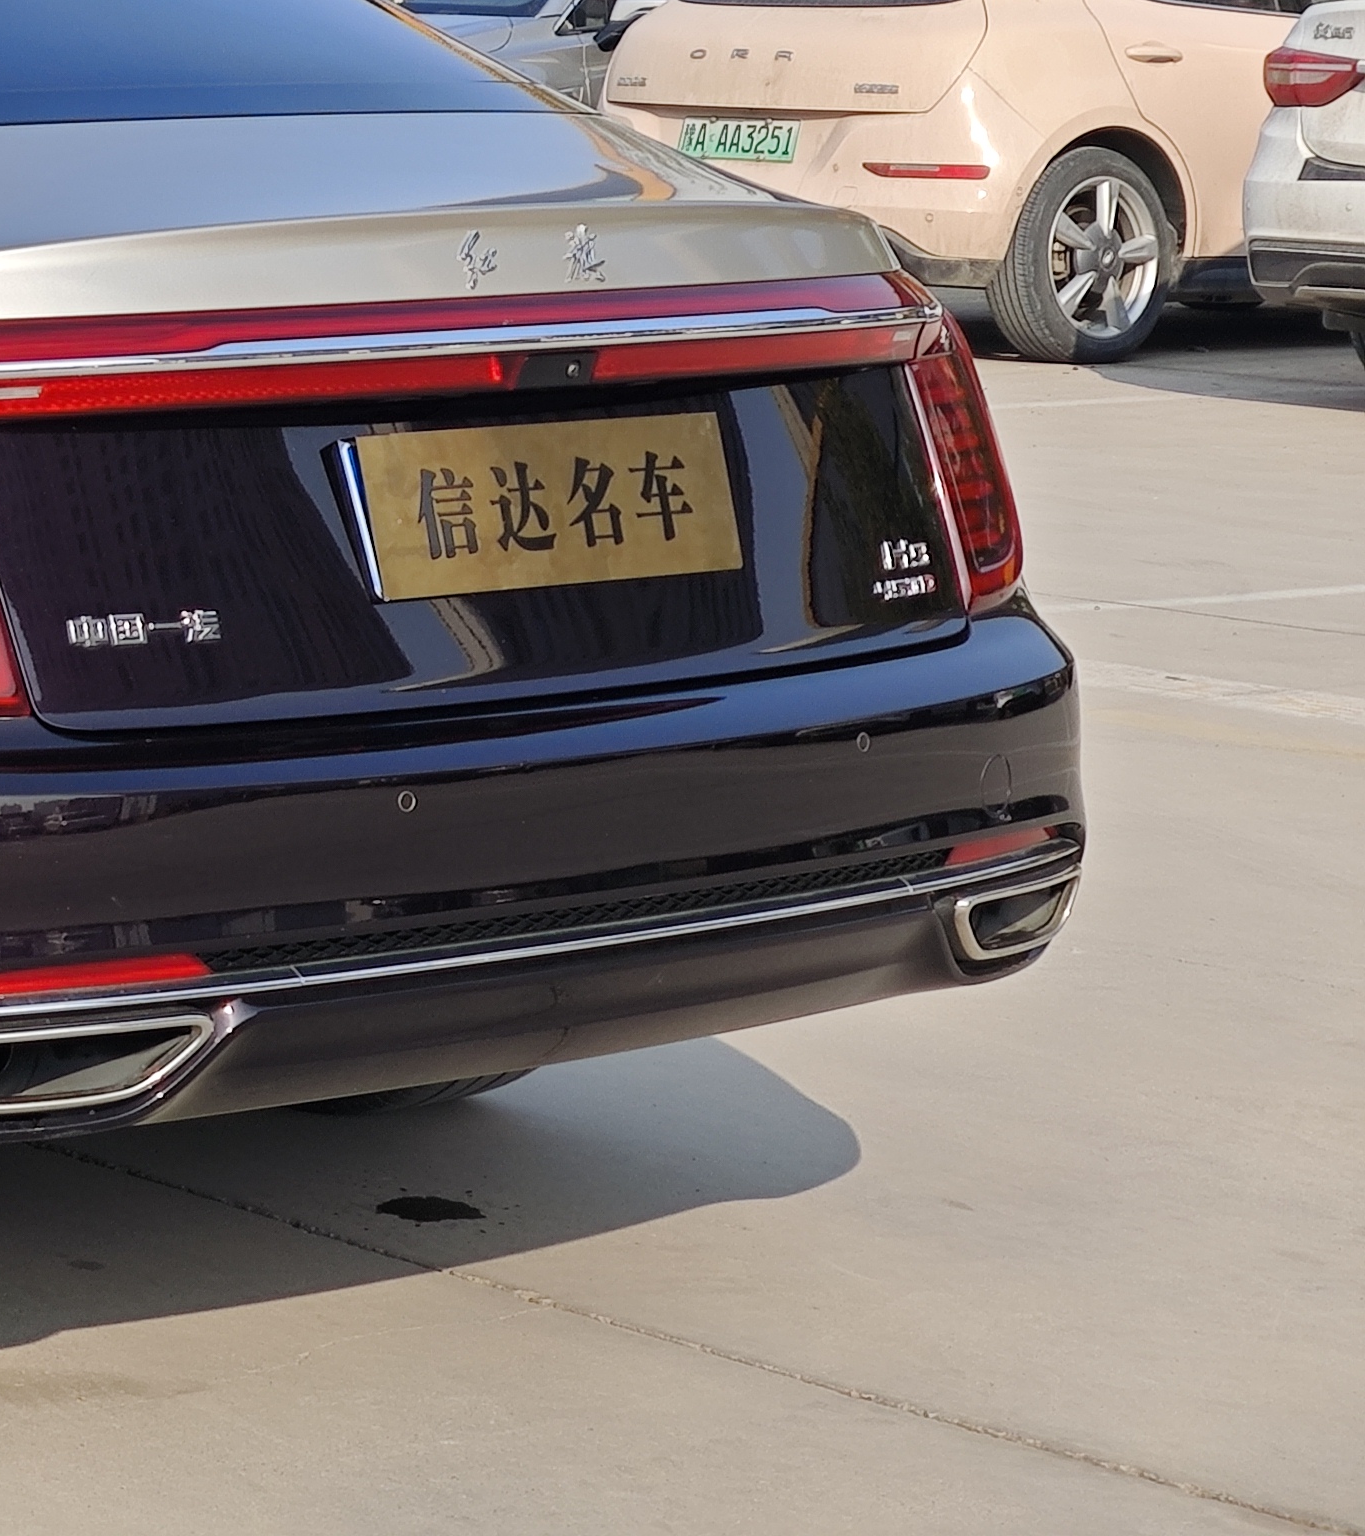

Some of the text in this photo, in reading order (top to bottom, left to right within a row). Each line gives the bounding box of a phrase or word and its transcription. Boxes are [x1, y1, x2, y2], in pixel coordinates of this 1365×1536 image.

[690, 49, 794, 61] ORA
[418, 451, 693, 560] 信达名车
[66, 610, 221, 648] 中国一汽
